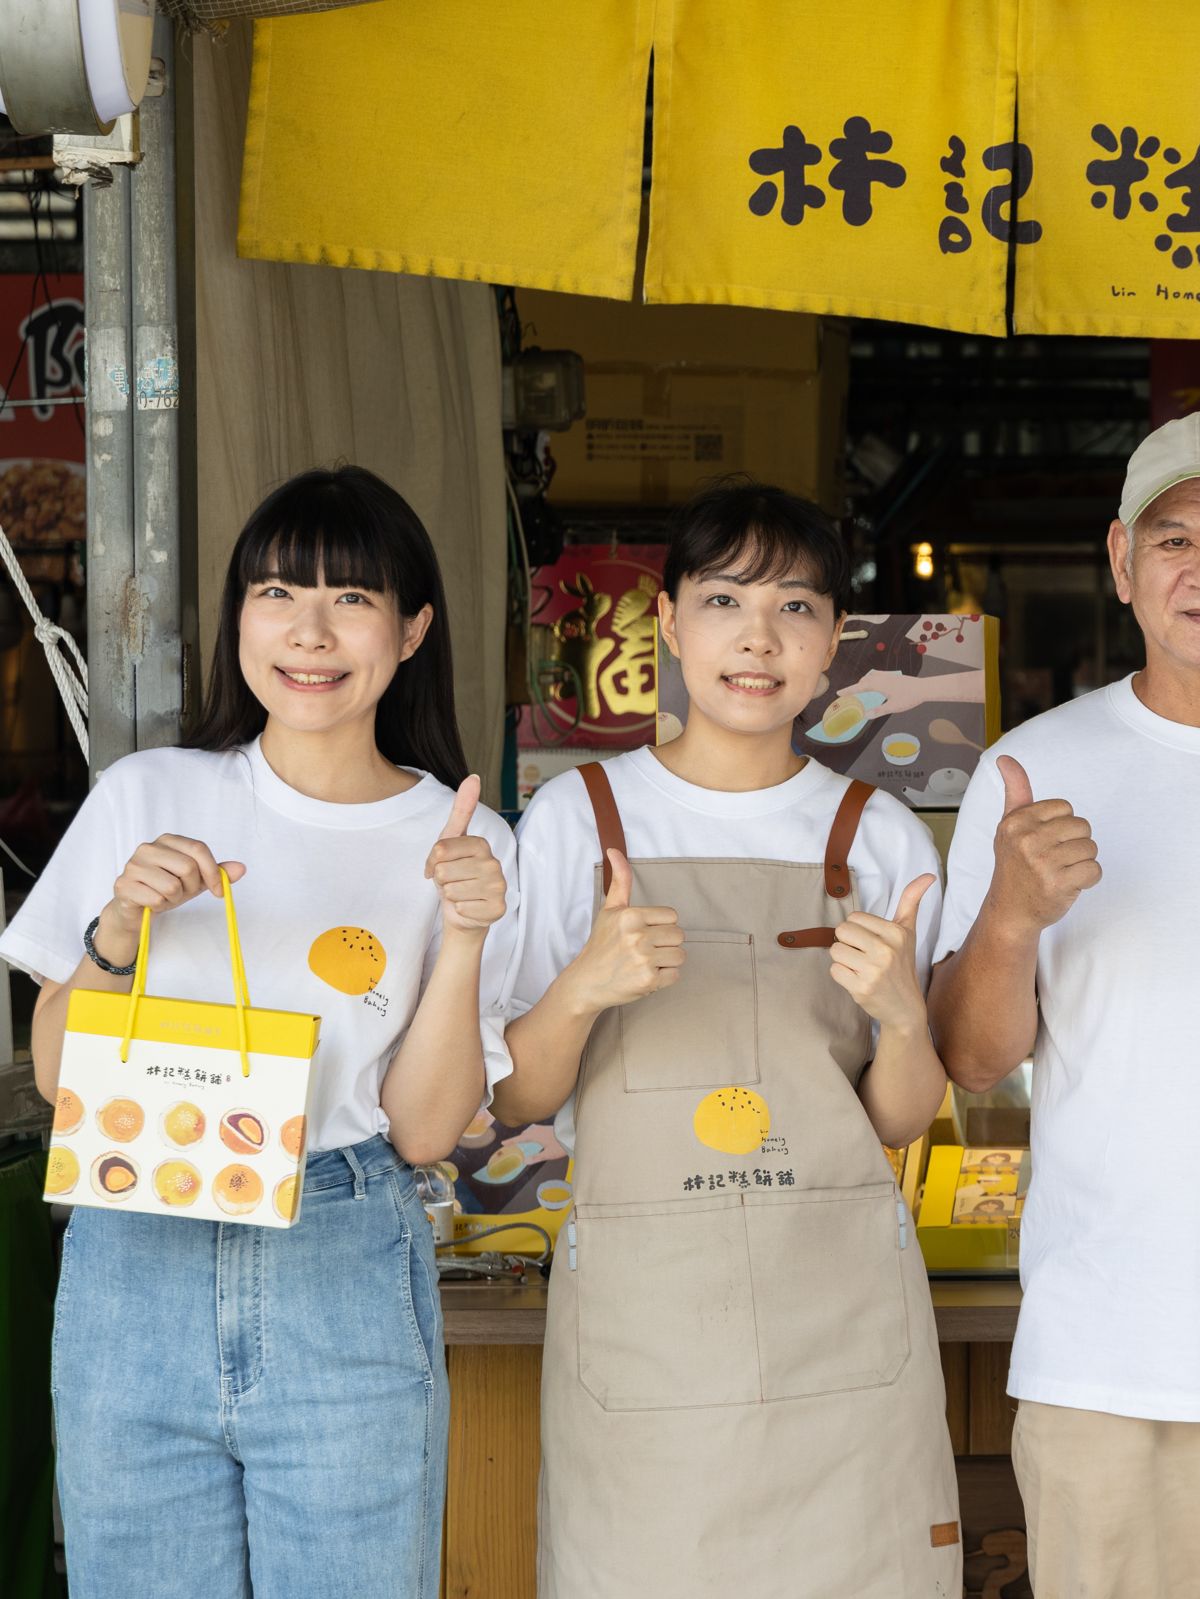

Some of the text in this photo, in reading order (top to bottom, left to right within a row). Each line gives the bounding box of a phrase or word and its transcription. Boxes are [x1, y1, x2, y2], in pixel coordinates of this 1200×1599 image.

[1111, 284, 1136, 297] Lin
[146, 1065, 223, 1085] 林記糕餅舖
[683, 1168, 796, 1192] 林記糕餅舖
